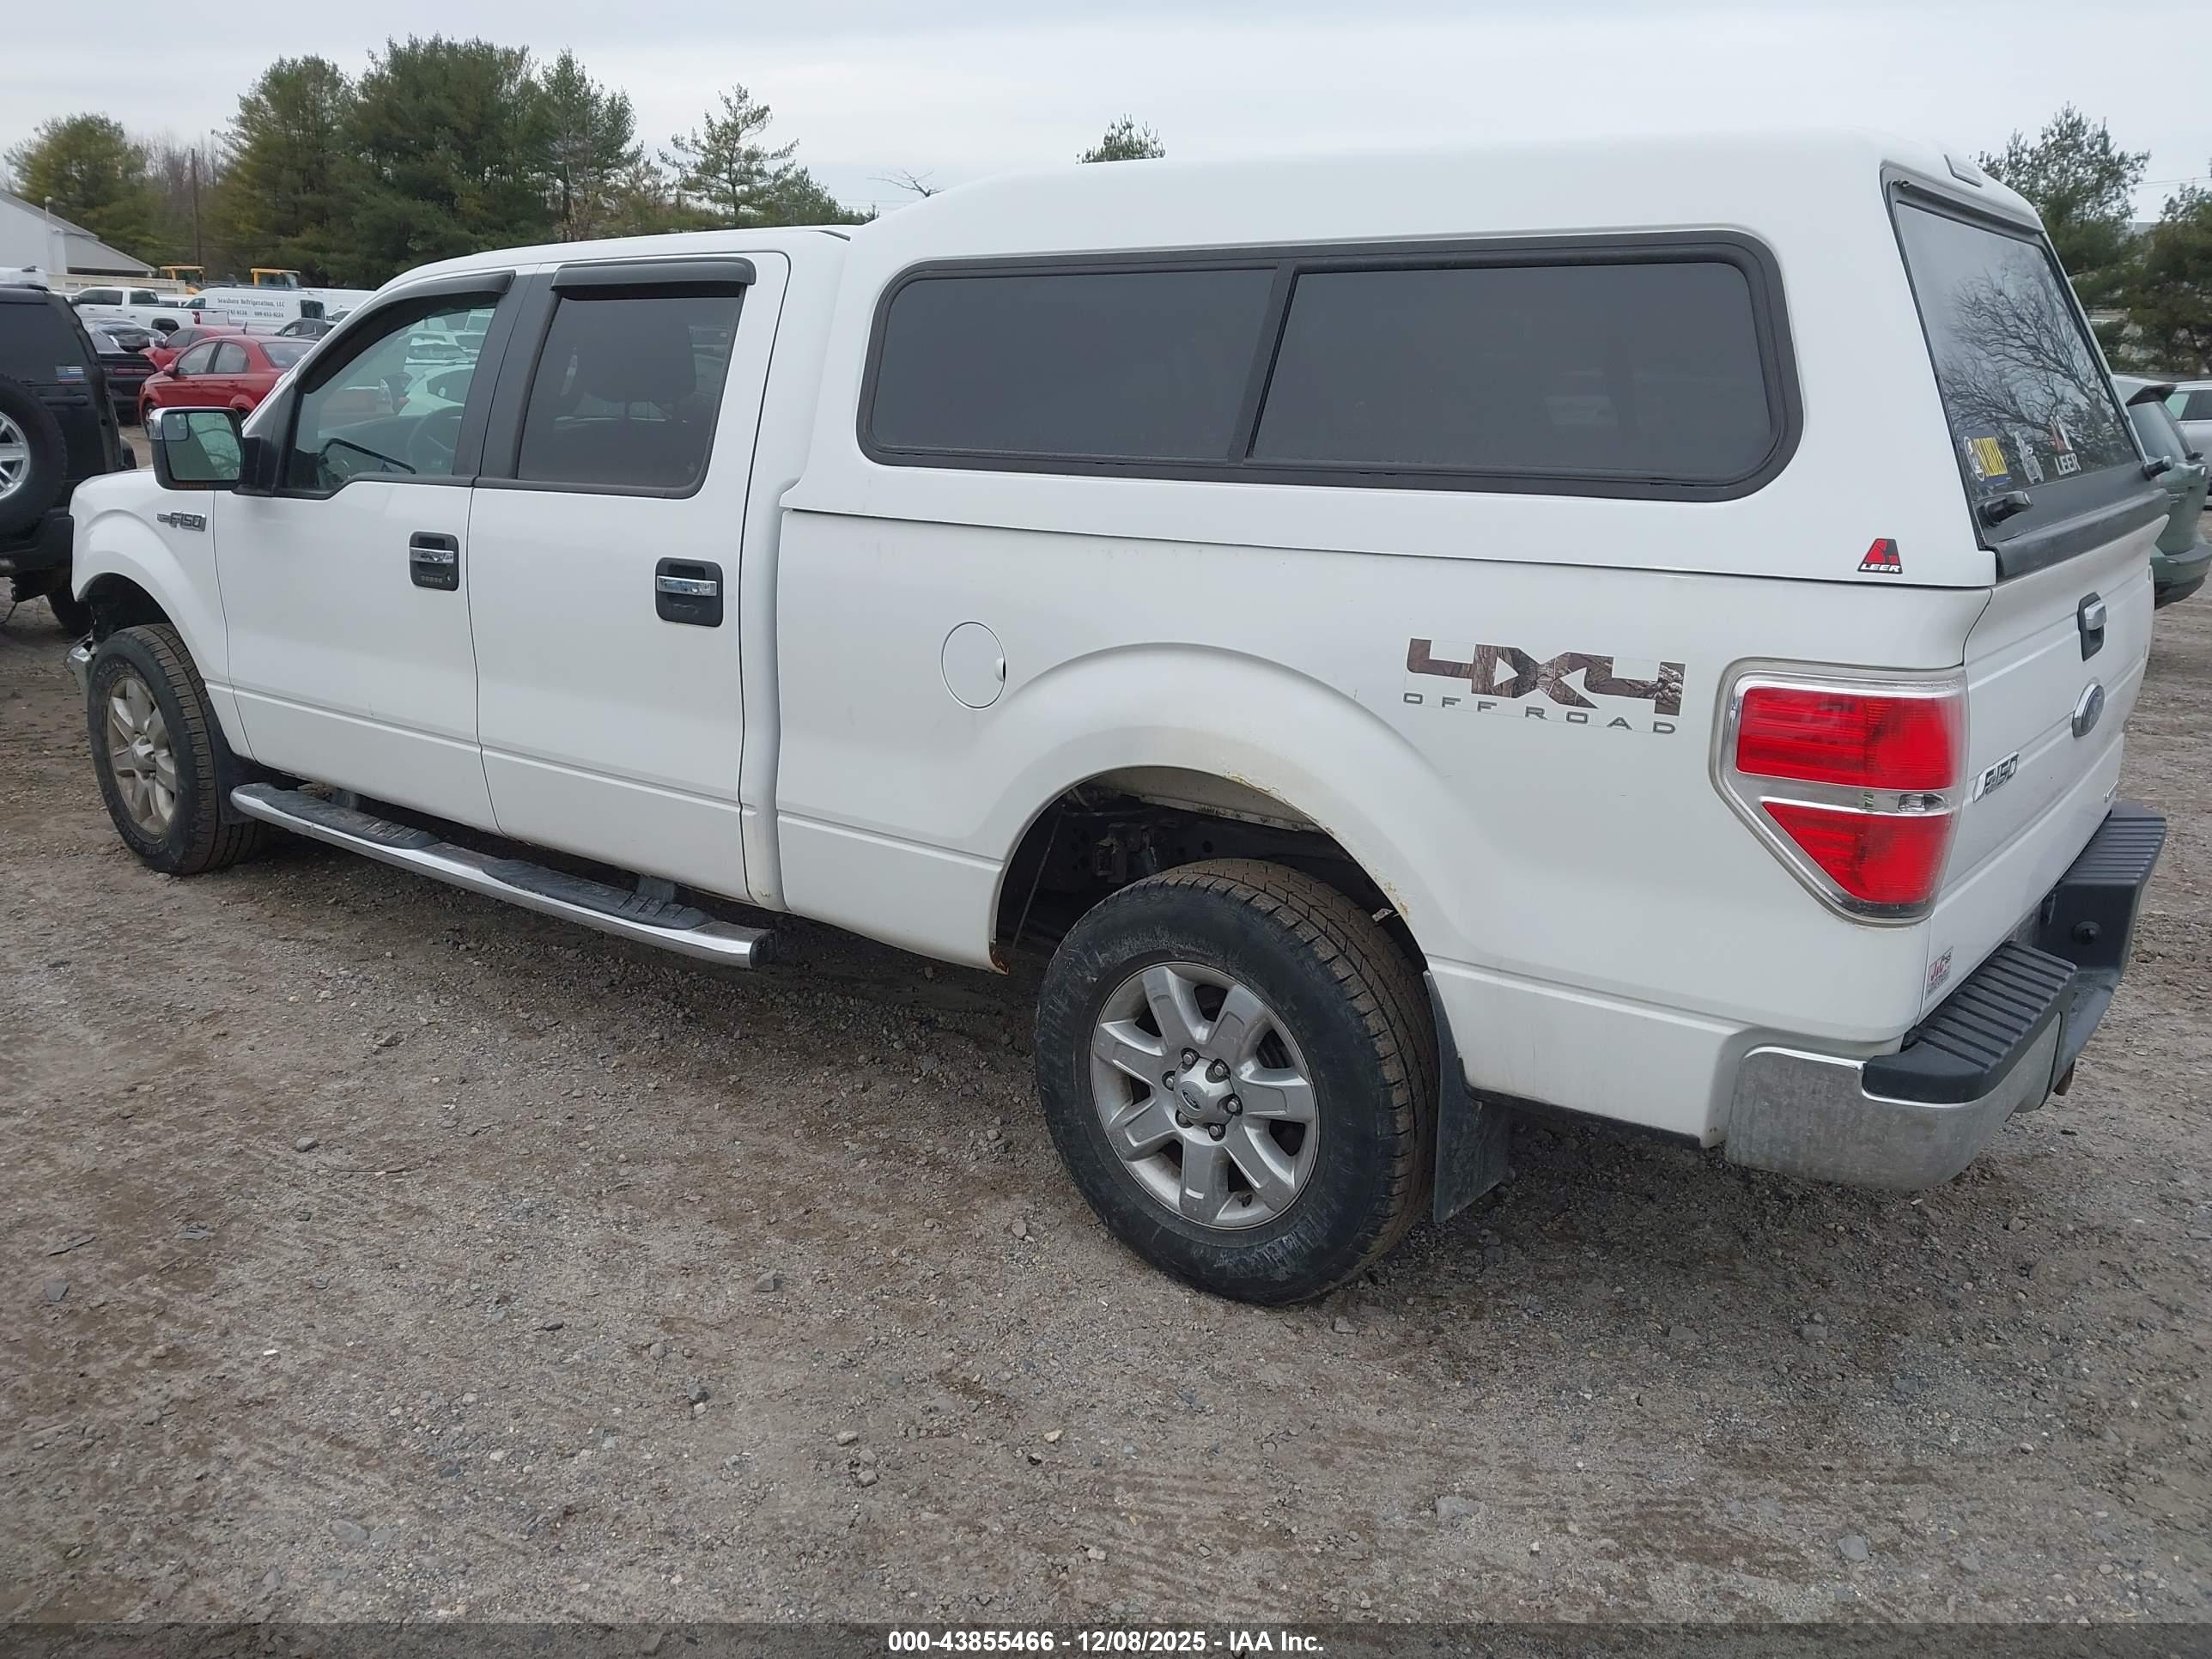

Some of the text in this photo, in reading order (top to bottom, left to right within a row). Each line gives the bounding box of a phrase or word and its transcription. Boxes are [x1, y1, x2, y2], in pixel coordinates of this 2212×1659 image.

[240, 298, 275, 307] Refrigeration,
[2054, 453, 2082, 476] LEER
[1860, 563, 1901, 573] LEER
